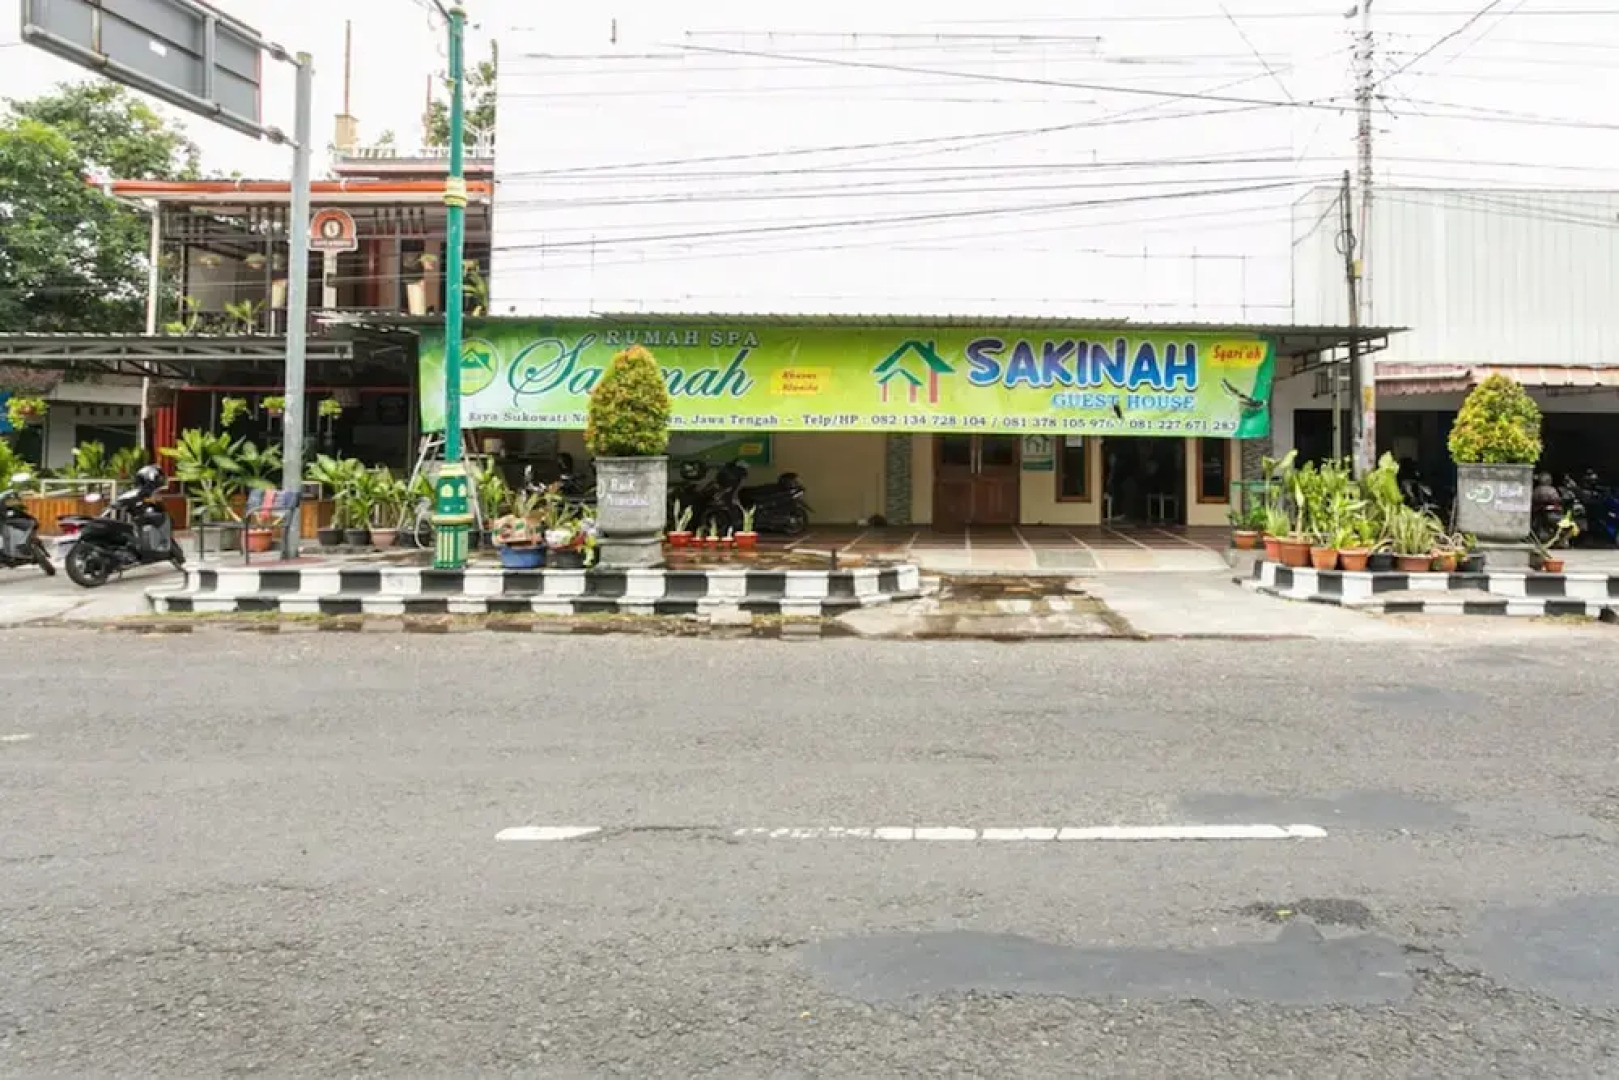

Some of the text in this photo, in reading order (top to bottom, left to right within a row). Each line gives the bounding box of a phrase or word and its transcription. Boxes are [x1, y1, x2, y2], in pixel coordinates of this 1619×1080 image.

[606, 330, 759, 346] RUMAH SPA
[508, 333, 754, 406] Sanah
[967, 337, 1199, 391] SAKINAH
[1052, 393, 1195, 410] GUEST HOUSE
[503, 411, 567, 422] Sukowati
[691, 414, 724, 424] Jawa
[730, 414, 778, 427] Tengah
[803, 414, 859, 427] Telp/HP
[871, 415, 897, 425] 082
[904, 415, 926, 425] 134
[962, 416, 986, 426] 104
[1003, 417, 1026, 427] 081
